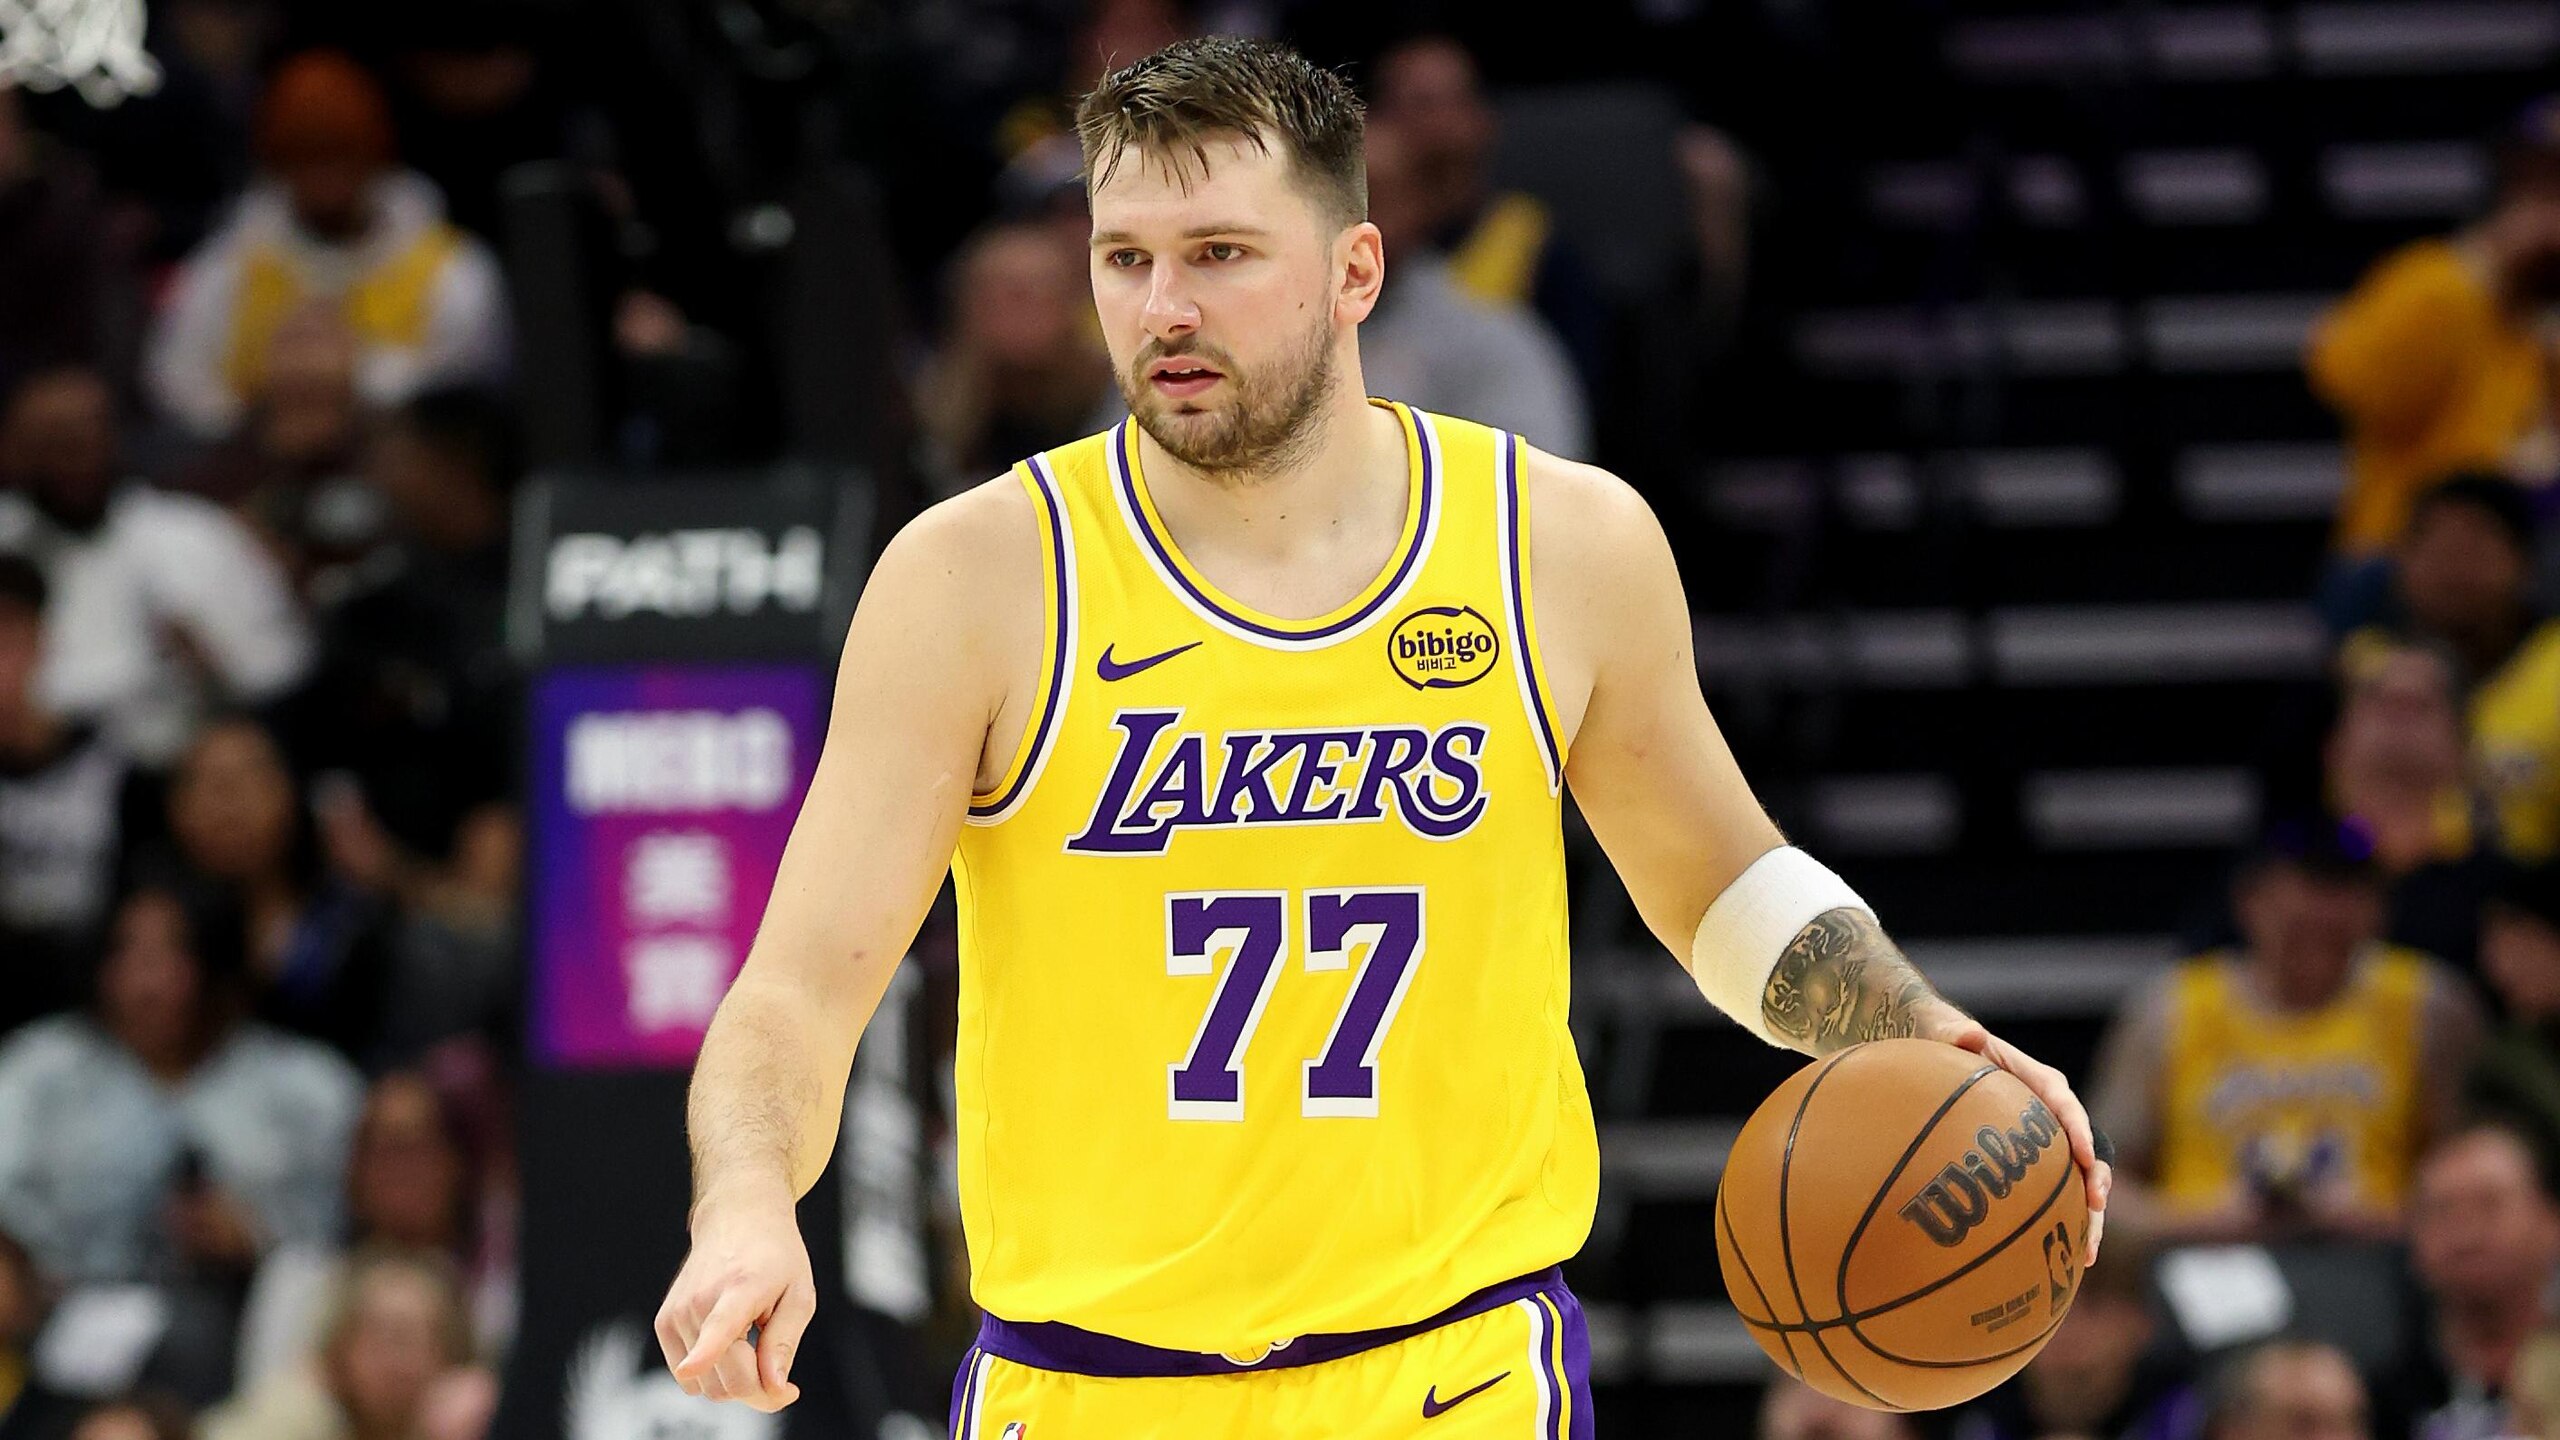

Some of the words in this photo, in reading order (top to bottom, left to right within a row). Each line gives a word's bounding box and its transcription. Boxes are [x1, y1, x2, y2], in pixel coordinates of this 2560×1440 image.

[1398, 628, 1492, 662] bibigo
[1416, 657, 1457, 672] 비비고
[1063, 707, 1491, 857] LAKERS
[1164, 884, 1427, 1122] 77
